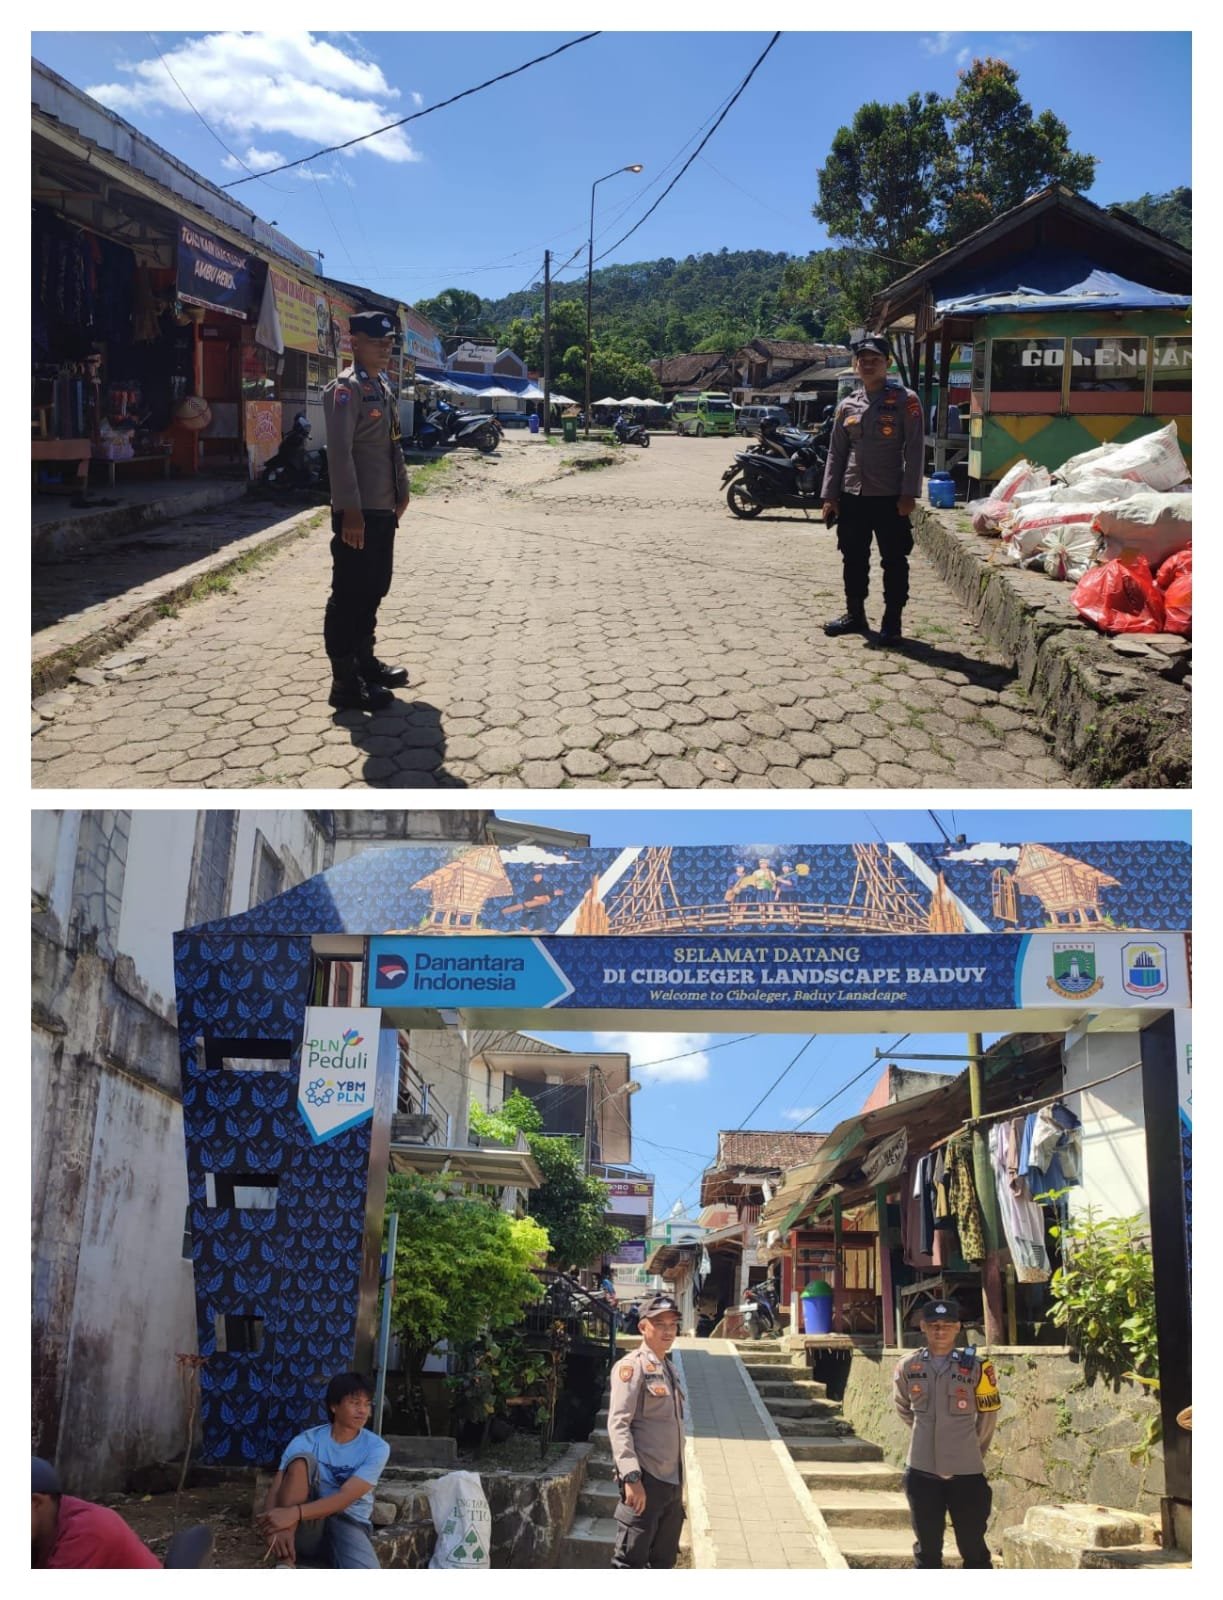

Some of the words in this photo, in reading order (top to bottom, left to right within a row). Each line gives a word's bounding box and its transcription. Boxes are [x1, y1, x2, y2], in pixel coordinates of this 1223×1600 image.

[415, 953, 525, 971] Danantara
[674, 947, 768, 963] SELAMAT
[773, 946, 861, 963] DATANG
[413, 973, 516, 991] Indonesia
[603, 968, 627, 984] DI
[631, 968, 756, 985] CIBOLEGER
[761, 968, 901, 985] LANDSCAPE
[906, 967, 987, 984] BADUY
[650, 989, 708, 1001] Welcome
[710, 990, 722, 1001] to
[727, 989, 791, 1003] Ciboleger,
[794, 990, 835, 1004] Baduy
[838, 989, 908, 1003] Lansdcape
[310, 1039, 340, 1052] PLN
[308, 1051, 368, 1070] Peduli
[337, 1081, 366, 1092] YBM
[337, 1092, 366, 1103] PLN
